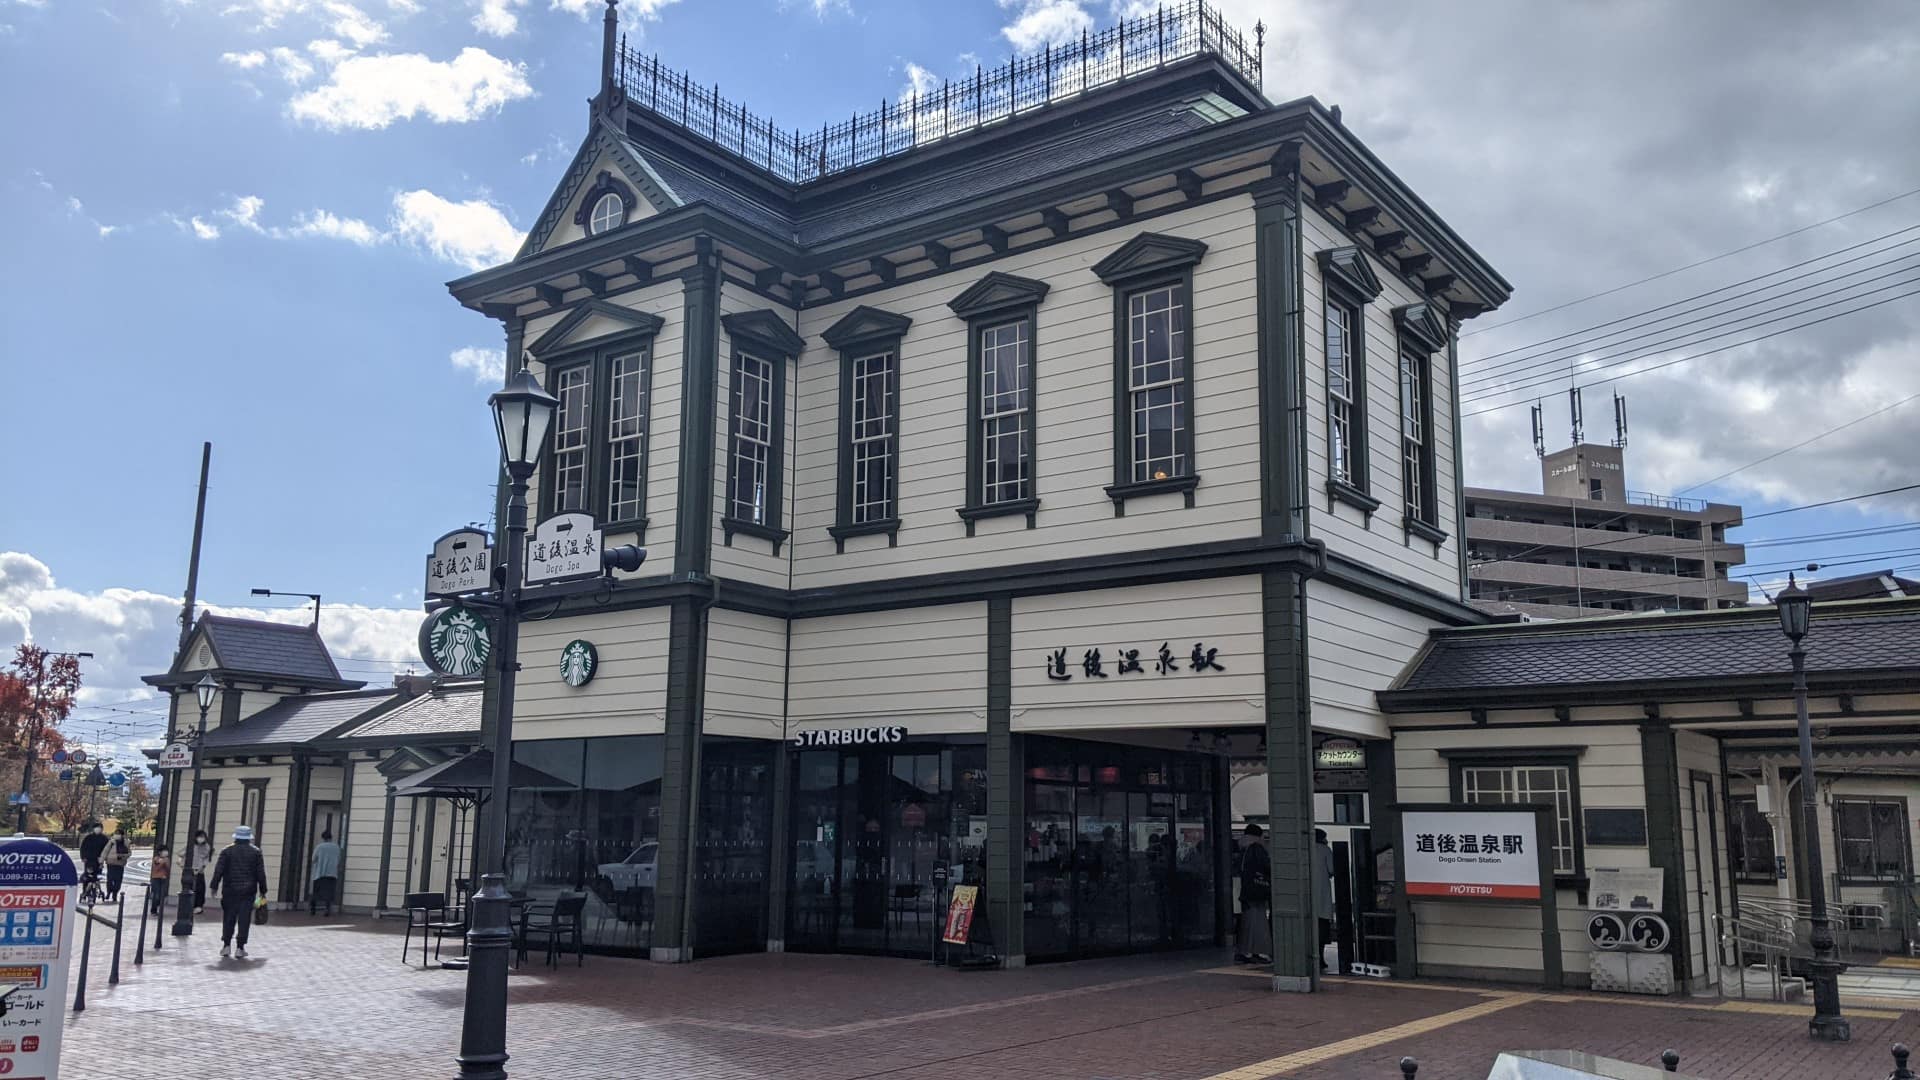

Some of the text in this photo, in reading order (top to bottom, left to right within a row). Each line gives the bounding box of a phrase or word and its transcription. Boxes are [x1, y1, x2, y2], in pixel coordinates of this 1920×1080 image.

[533, 533, 596, 562] 道後温泉
[432, 552, 486, 578] 道後公園
[1047, 642, 1226, 681] 道後温泉駅
[795, 726, 902, 746] STARBUCKS
[1416, 833, 1524, 854] 道後温泉駅
[1438, 855, 1456, 863] Dogo
[1478, 856, 1502, 864] Station
[1449, 884, 1493, 894] IYOTETSU
[0, 893, 60, 907] OTETSU
